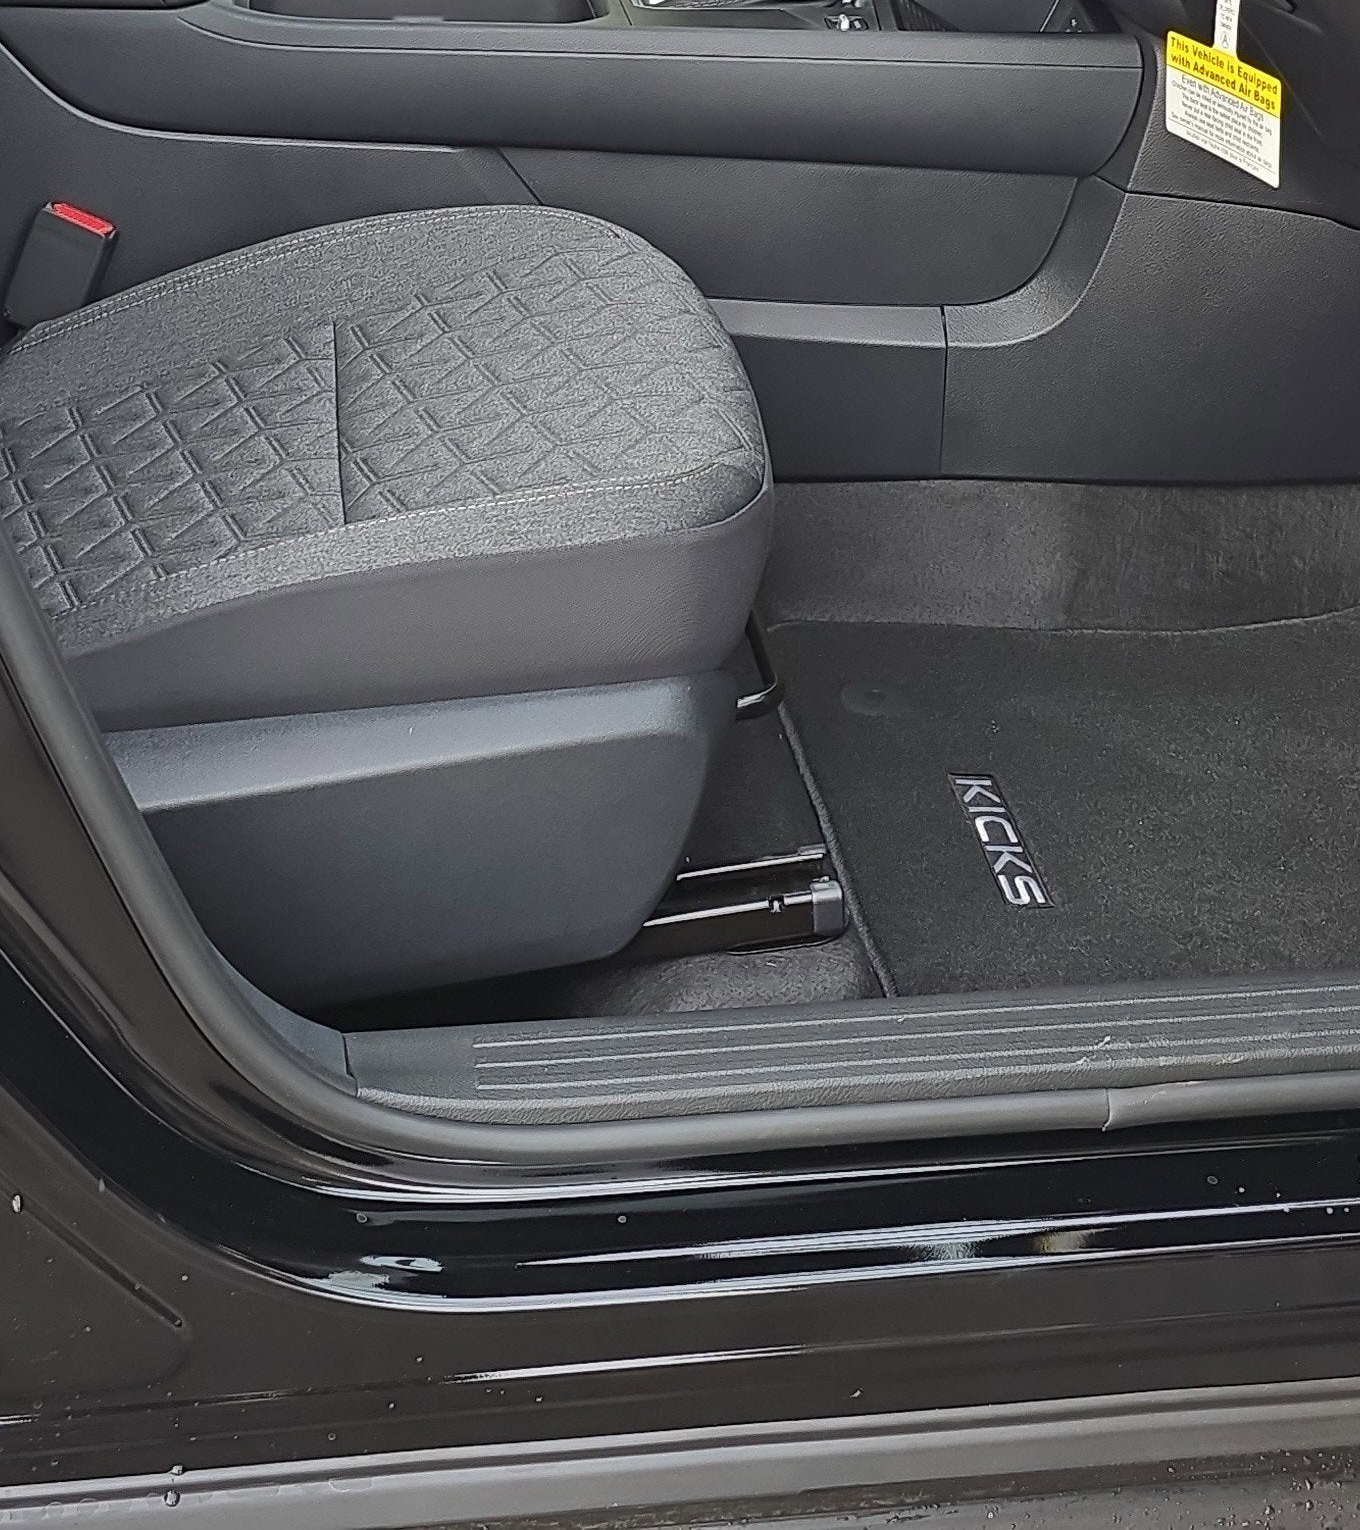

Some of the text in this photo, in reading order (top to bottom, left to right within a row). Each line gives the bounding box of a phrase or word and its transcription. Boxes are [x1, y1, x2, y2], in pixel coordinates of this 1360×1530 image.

[1170, 36, 1277, 97] This Vehicle is Equipped
[1171, 51, 1275, 112] with Advanced Air Bags
[955, 779, 1046, 905] KICKS
